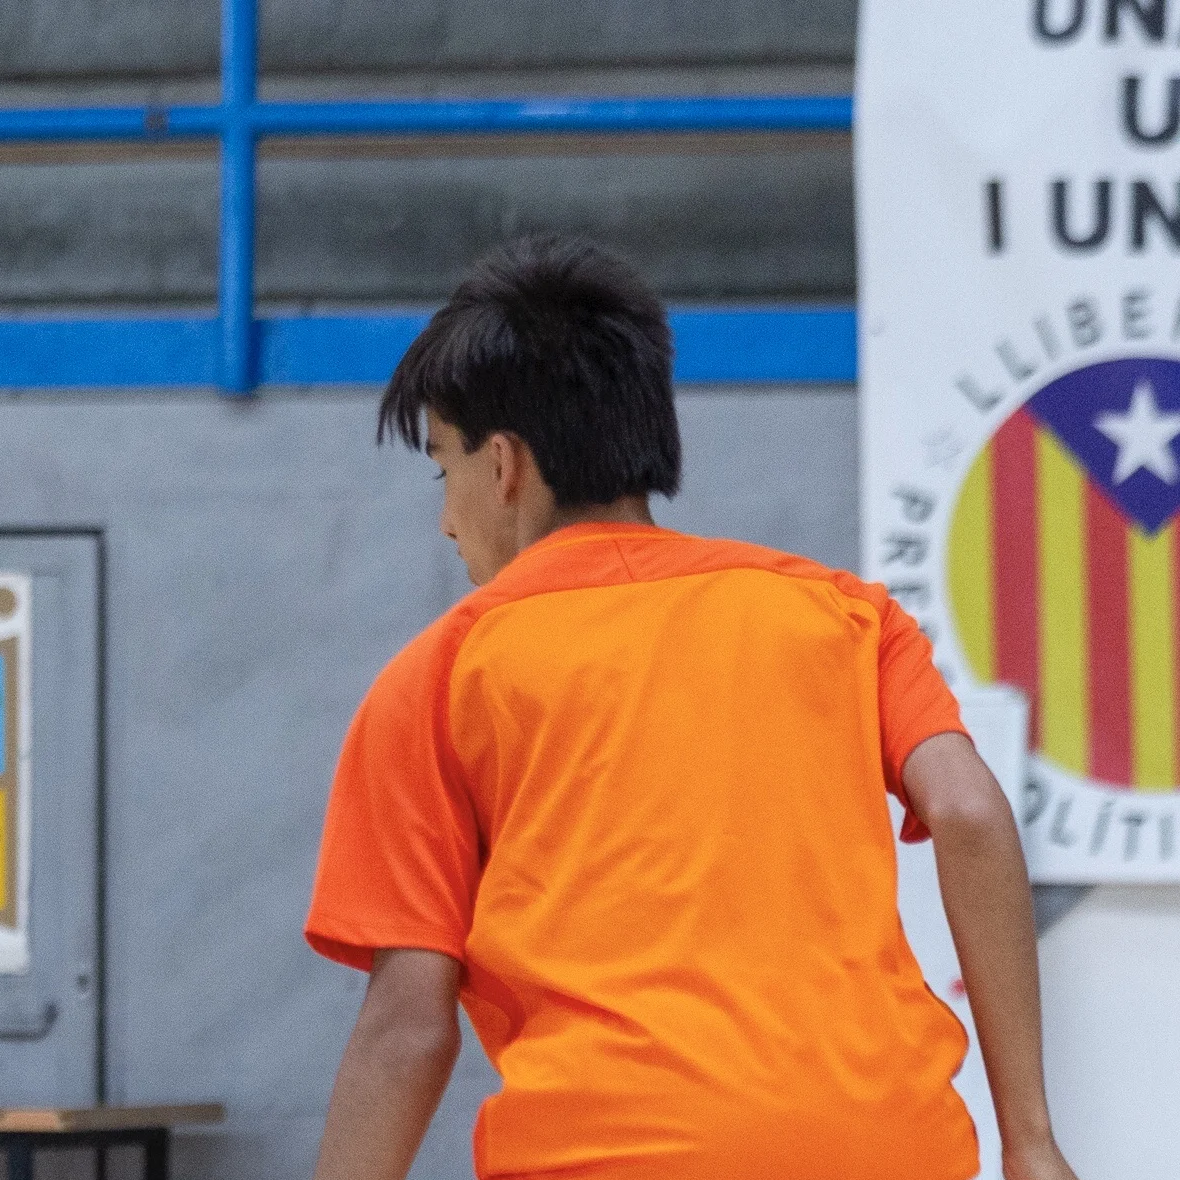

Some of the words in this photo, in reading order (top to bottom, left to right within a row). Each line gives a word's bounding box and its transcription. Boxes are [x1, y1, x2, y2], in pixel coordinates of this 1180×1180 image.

[1030, 0, 1180, 46] UN
[987, 178, 1004, 255] I
[955, 285, 1180, 415] LLIBE
